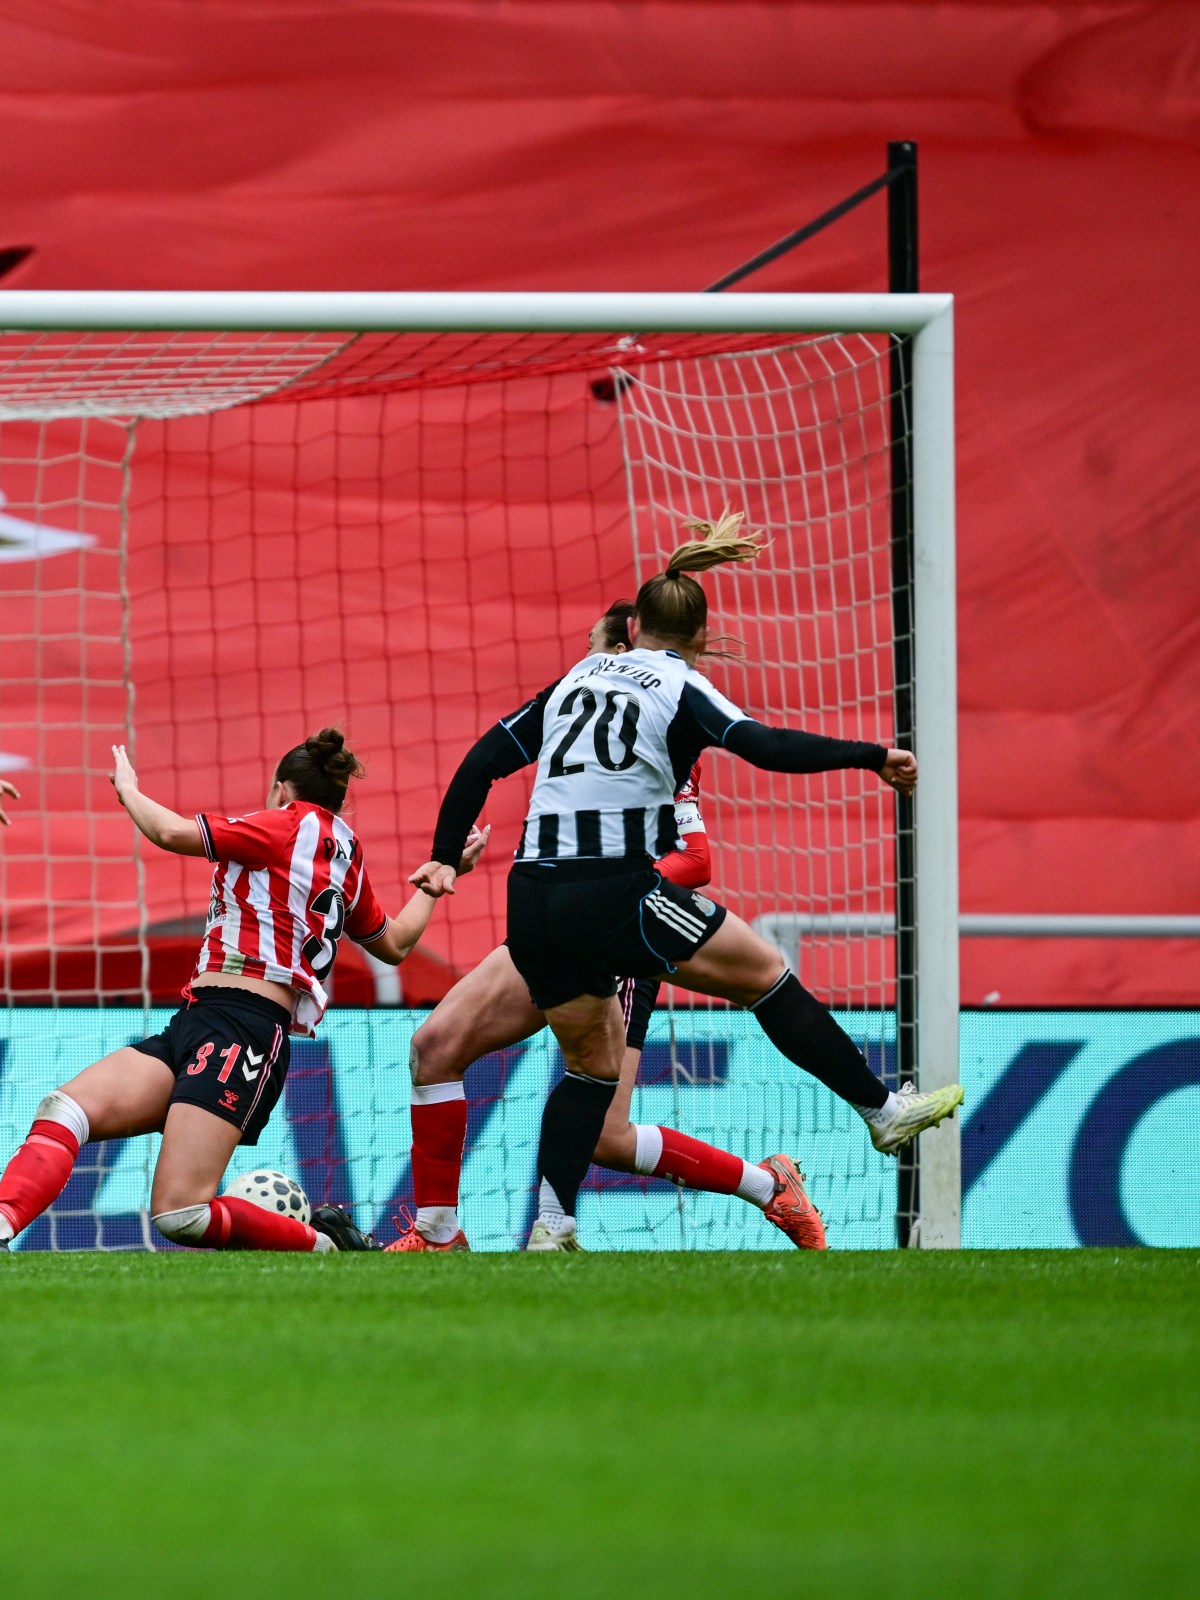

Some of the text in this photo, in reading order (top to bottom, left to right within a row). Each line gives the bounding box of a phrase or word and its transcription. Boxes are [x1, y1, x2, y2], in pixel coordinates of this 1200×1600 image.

[547, 686, 641, 778] 20
[323, 837, 363, 861] PAX
[302, 888, 352, 981] 3
[186, 1041, 242, 1084] 31
